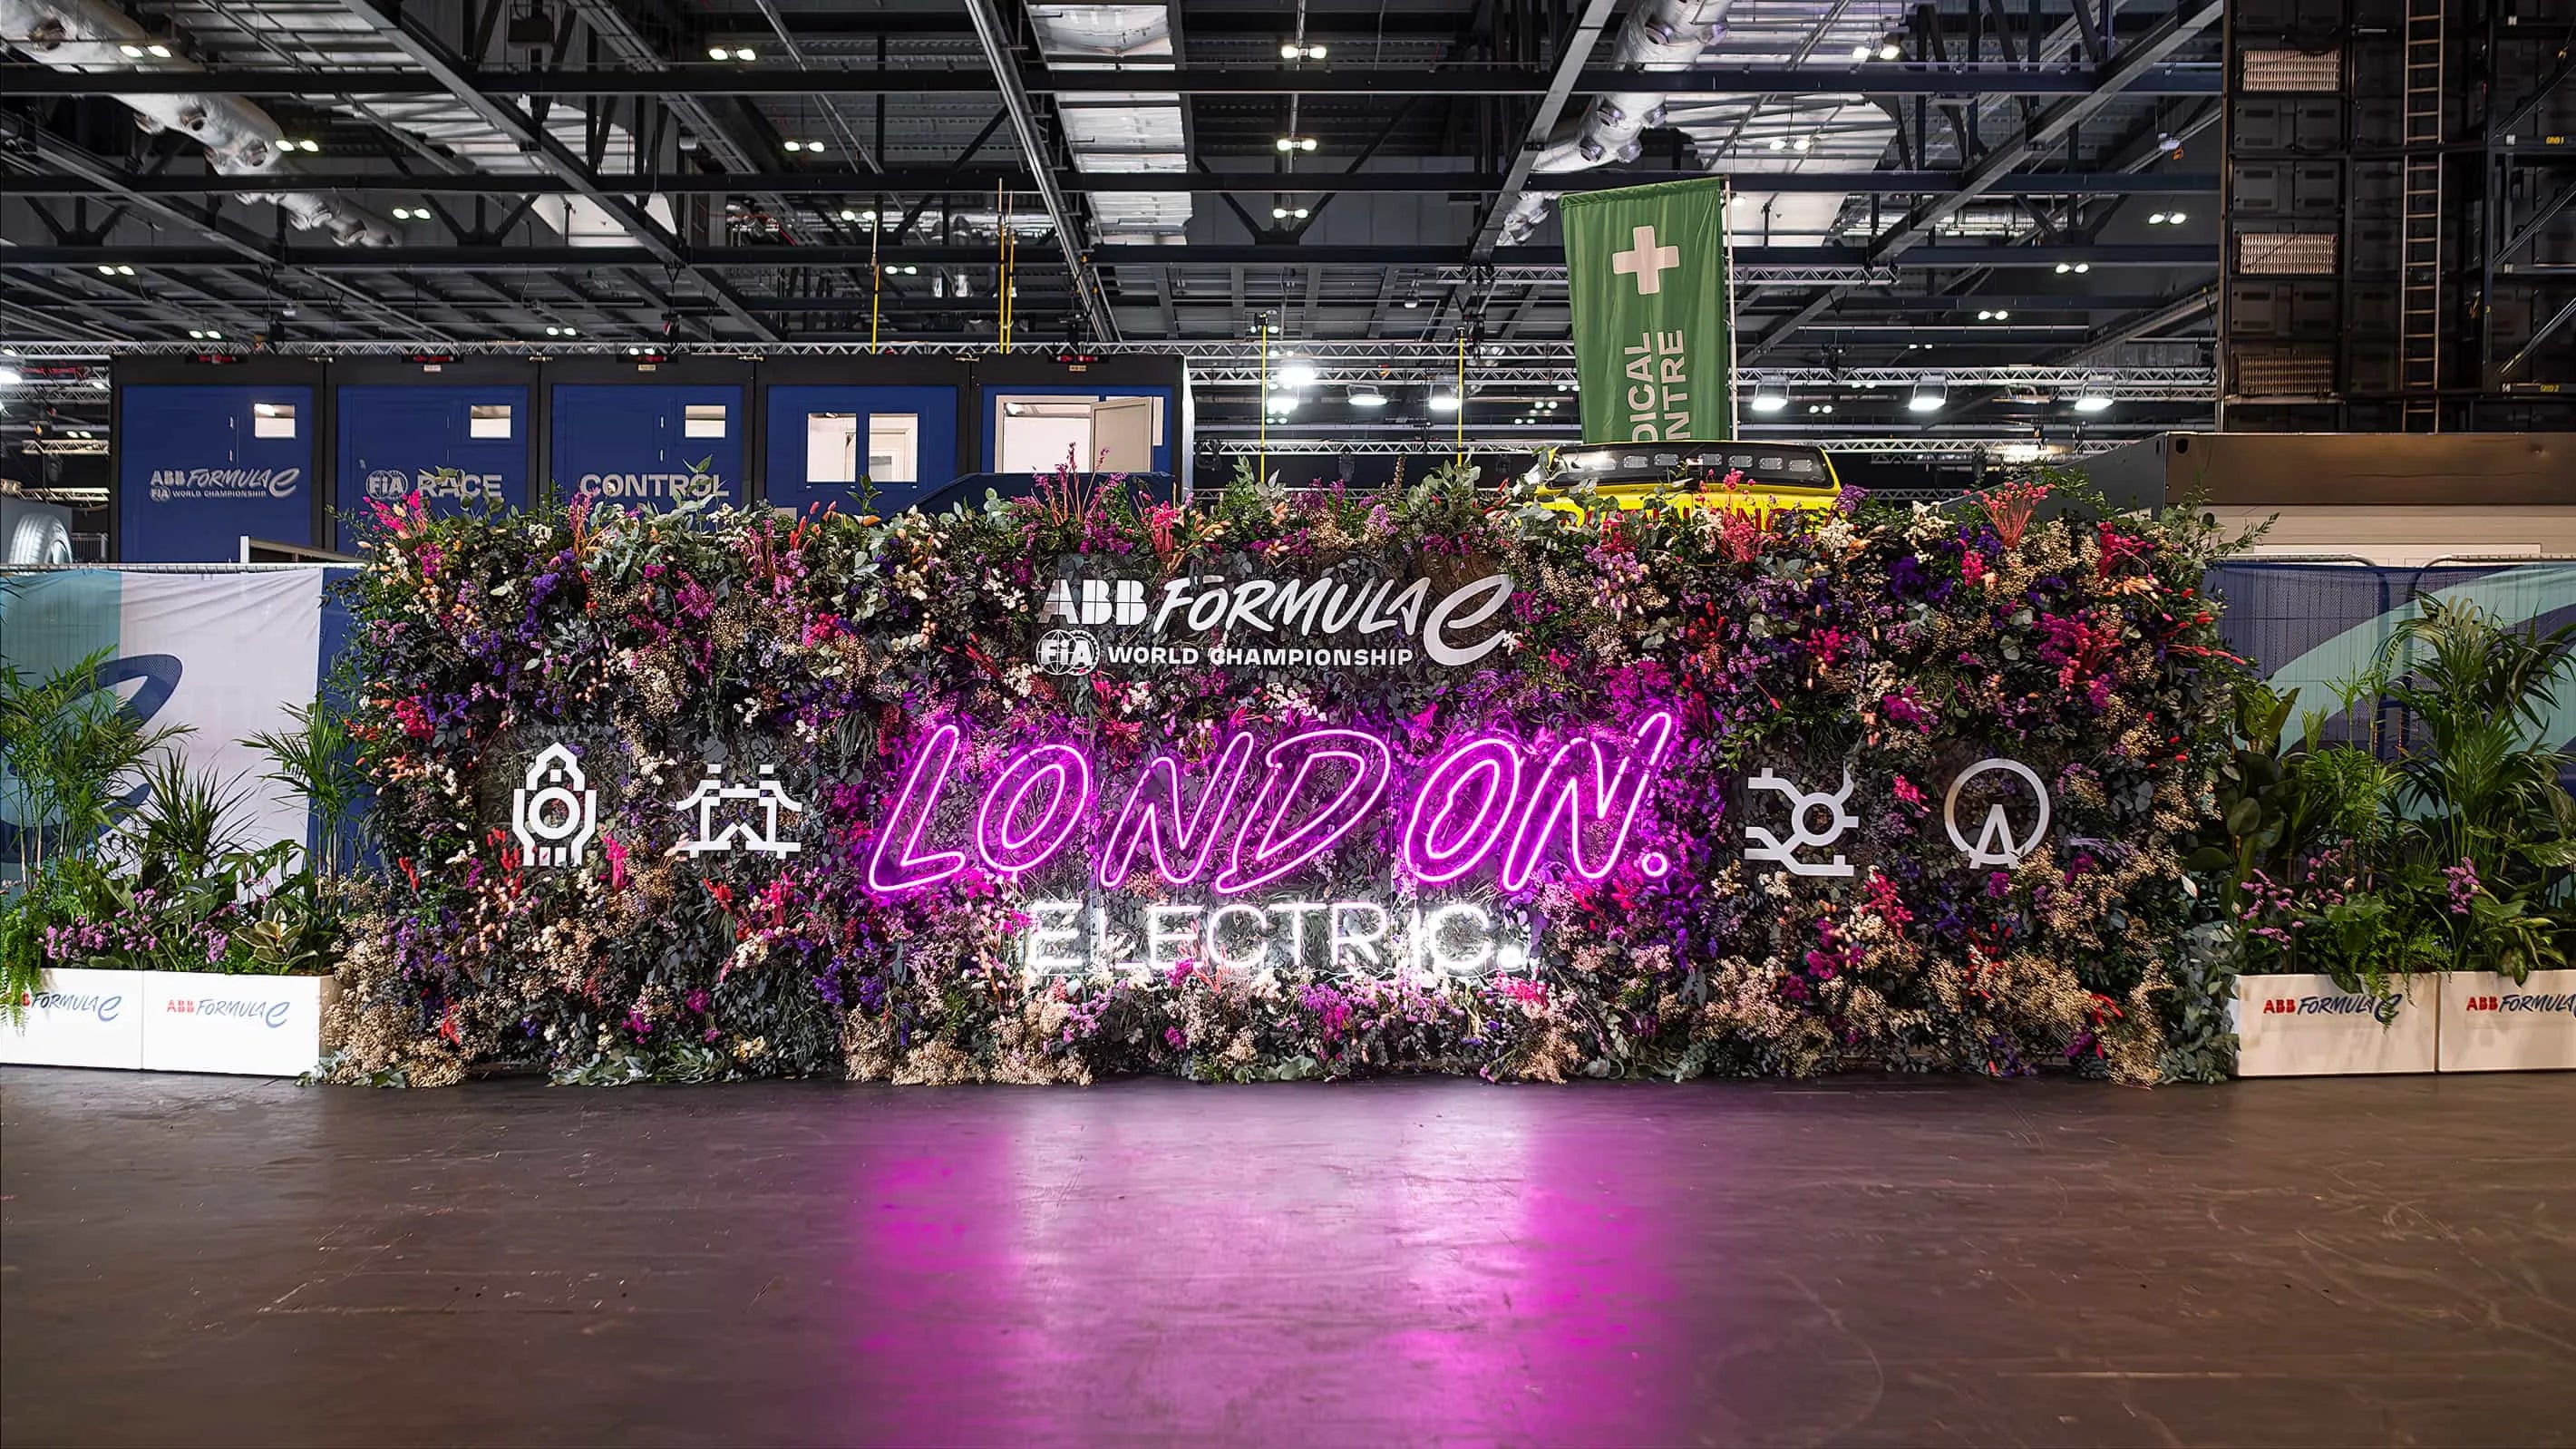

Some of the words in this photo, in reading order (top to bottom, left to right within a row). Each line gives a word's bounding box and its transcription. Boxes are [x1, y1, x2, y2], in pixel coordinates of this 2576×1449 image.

[1625, 332, 1658, 442] DICAL
[1657, 329, 1691, 440] NTRE
[151, 470, 186, 487] ABB
[186, 468, 271, 489] FORMULA
[417, 473, 502, 498] RACE
[579, 473, 730, 498] CONTROL
[172, 490, 202, 498] WORLD
[203, 490, 267, 498] CHAMPIONSHIP
[1037, 579, 1148, 626] ABB
[1152, 574, 1432, 636] FORMULA
[1107, 645, 1200, 666] WORLD
[1209, 646, 1414, 666] CHAMPIONSHIP
[868, 711, 1672, 894] LONDON.
[1027, 901, 1524, 970] ELECTRIC.
[31, 992, 100, 1013] FORMULA
[167, 999, 195, 1013] ABB
[196, 998, 267, 1018] FORMULA
[2263, 999, 2296, 1014] ABB
[2298, 996, 2377, 1015] FORMULA
[2466, 996, 2498, 1012] ABB
[2499, 994, 2576, 1013] FORMULA
